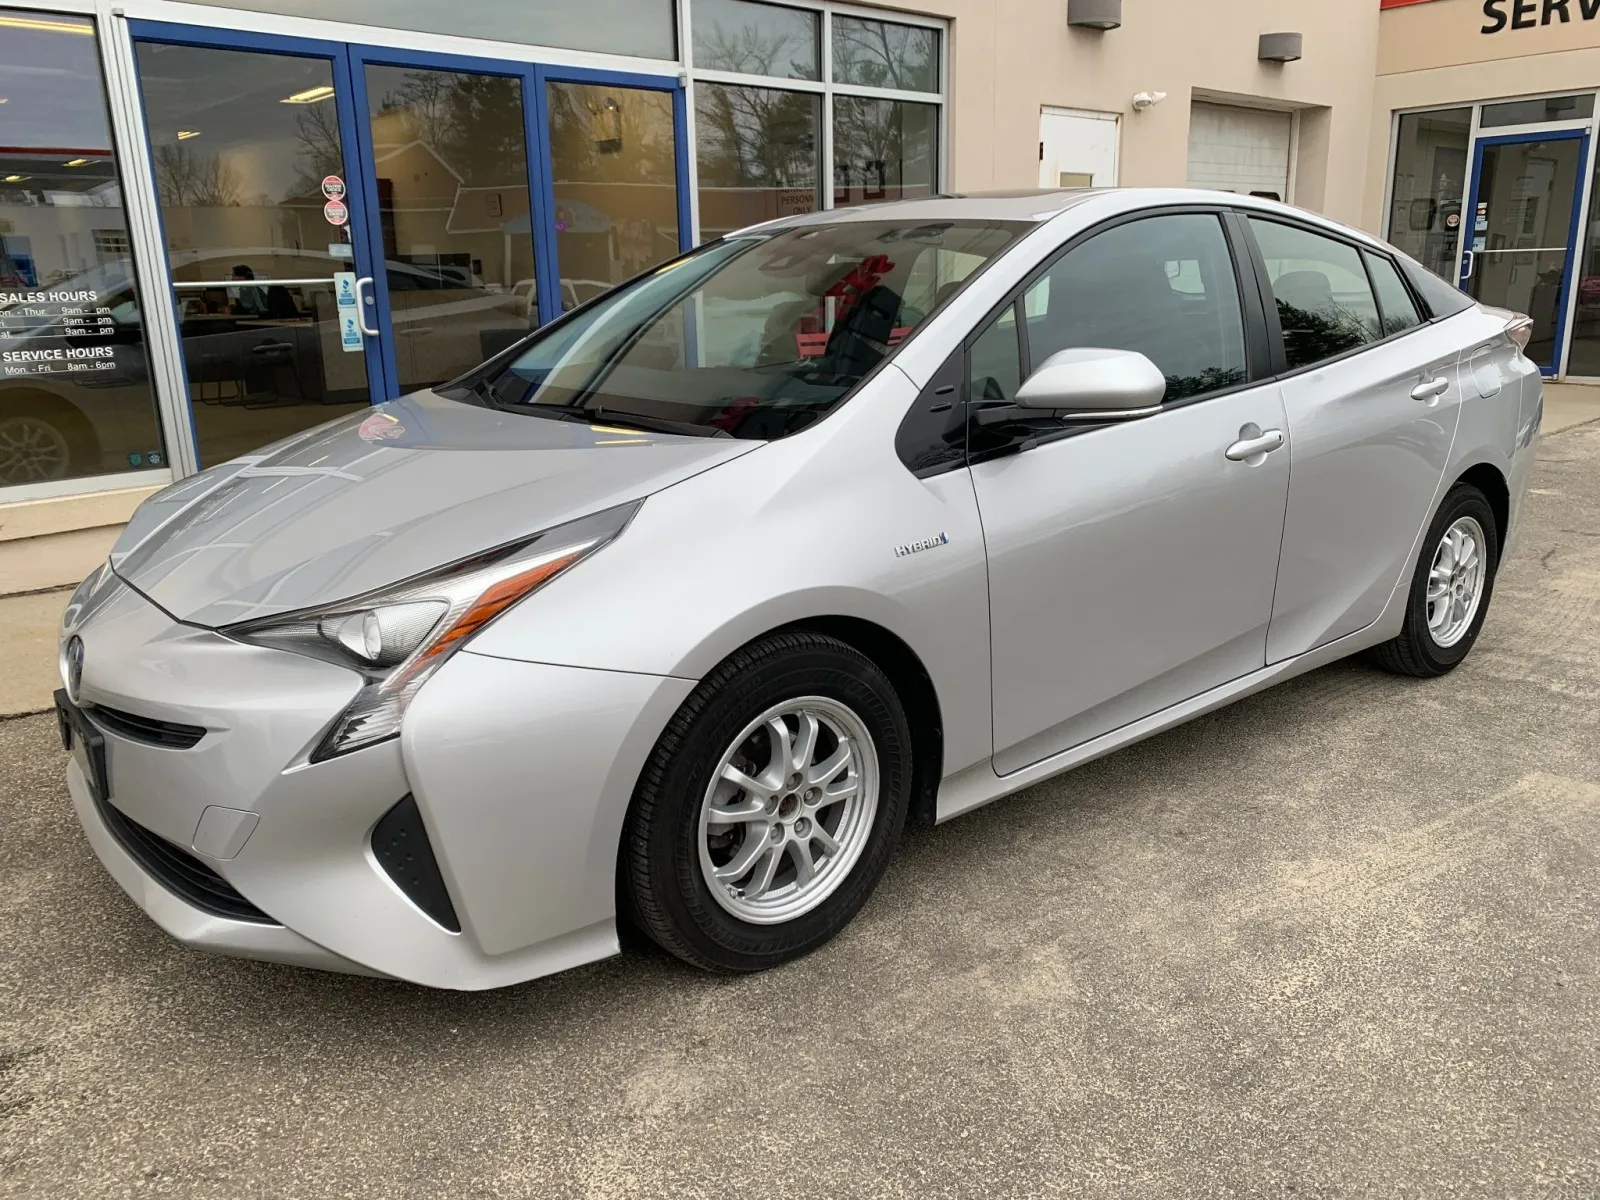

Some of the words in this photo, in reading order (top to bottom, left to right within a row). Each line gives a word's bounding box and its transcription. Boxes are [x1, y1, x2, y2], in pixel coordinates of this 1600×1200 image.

[1480, 0, 1600, 34] SERV
[0, 291, 46, 303] SALES
[48, 290, 98, 302] HOURS
[22, 307, 48, 316] Thur.
[61, 306, 82, 315] 9am
[95, 306, 111, 315] pm
[62, 317, 84, 325] 9am
[97, 316, 112, 325] pm
[64, 327, 86, 336] 9am
[99, 326, 115, 335] pm
[2, 349, 63, 362] SERVICE
[65, 346, 114, 358] HOURS
[4, 366, 30, 374] Mon.
[37, 364, 54, 372] Fri.
[67, 362, 88, 371] 8am
[95, 360, 116, 370] 6pm
[894, 536, 942, 557] HYBRID
